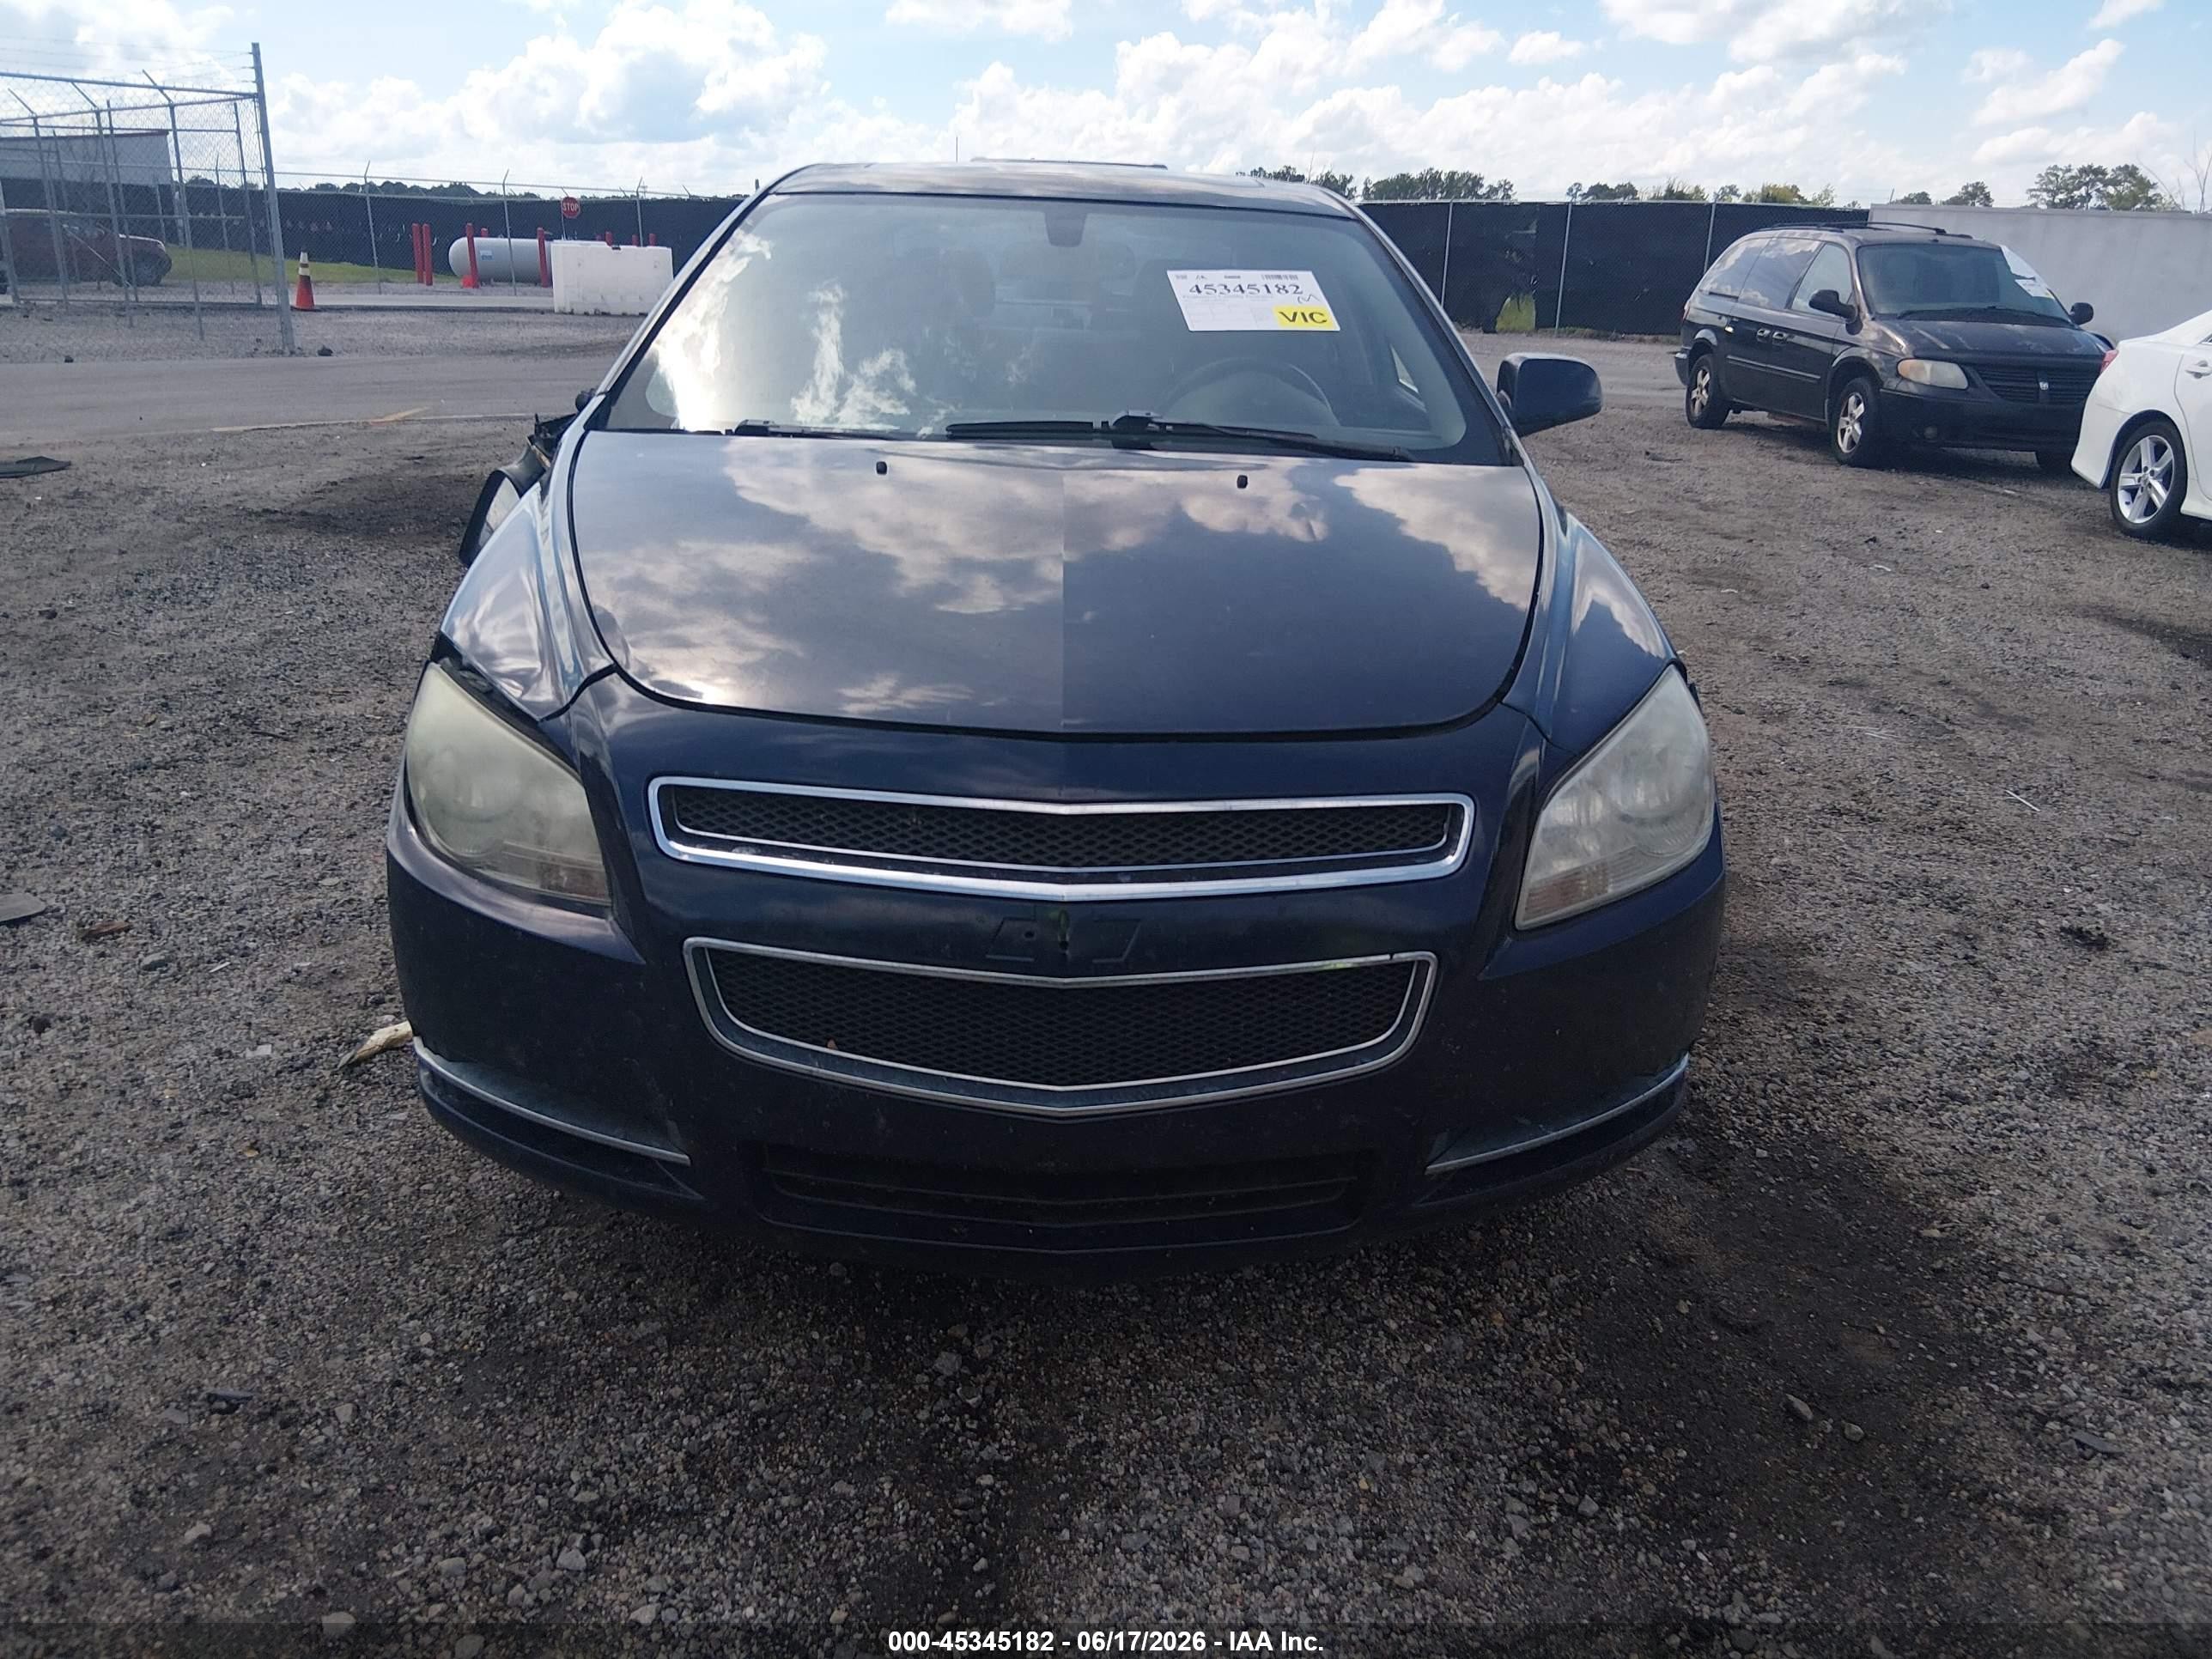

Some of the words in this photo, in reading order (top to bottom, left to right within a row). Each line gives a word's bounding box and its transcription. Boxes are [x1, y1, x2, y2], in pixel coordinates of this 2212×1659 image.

[562, 202, 579, 212] STOP
[1188, 283, 1304, 295] 45345182
[1279, 311, 1328, 325] VIC
